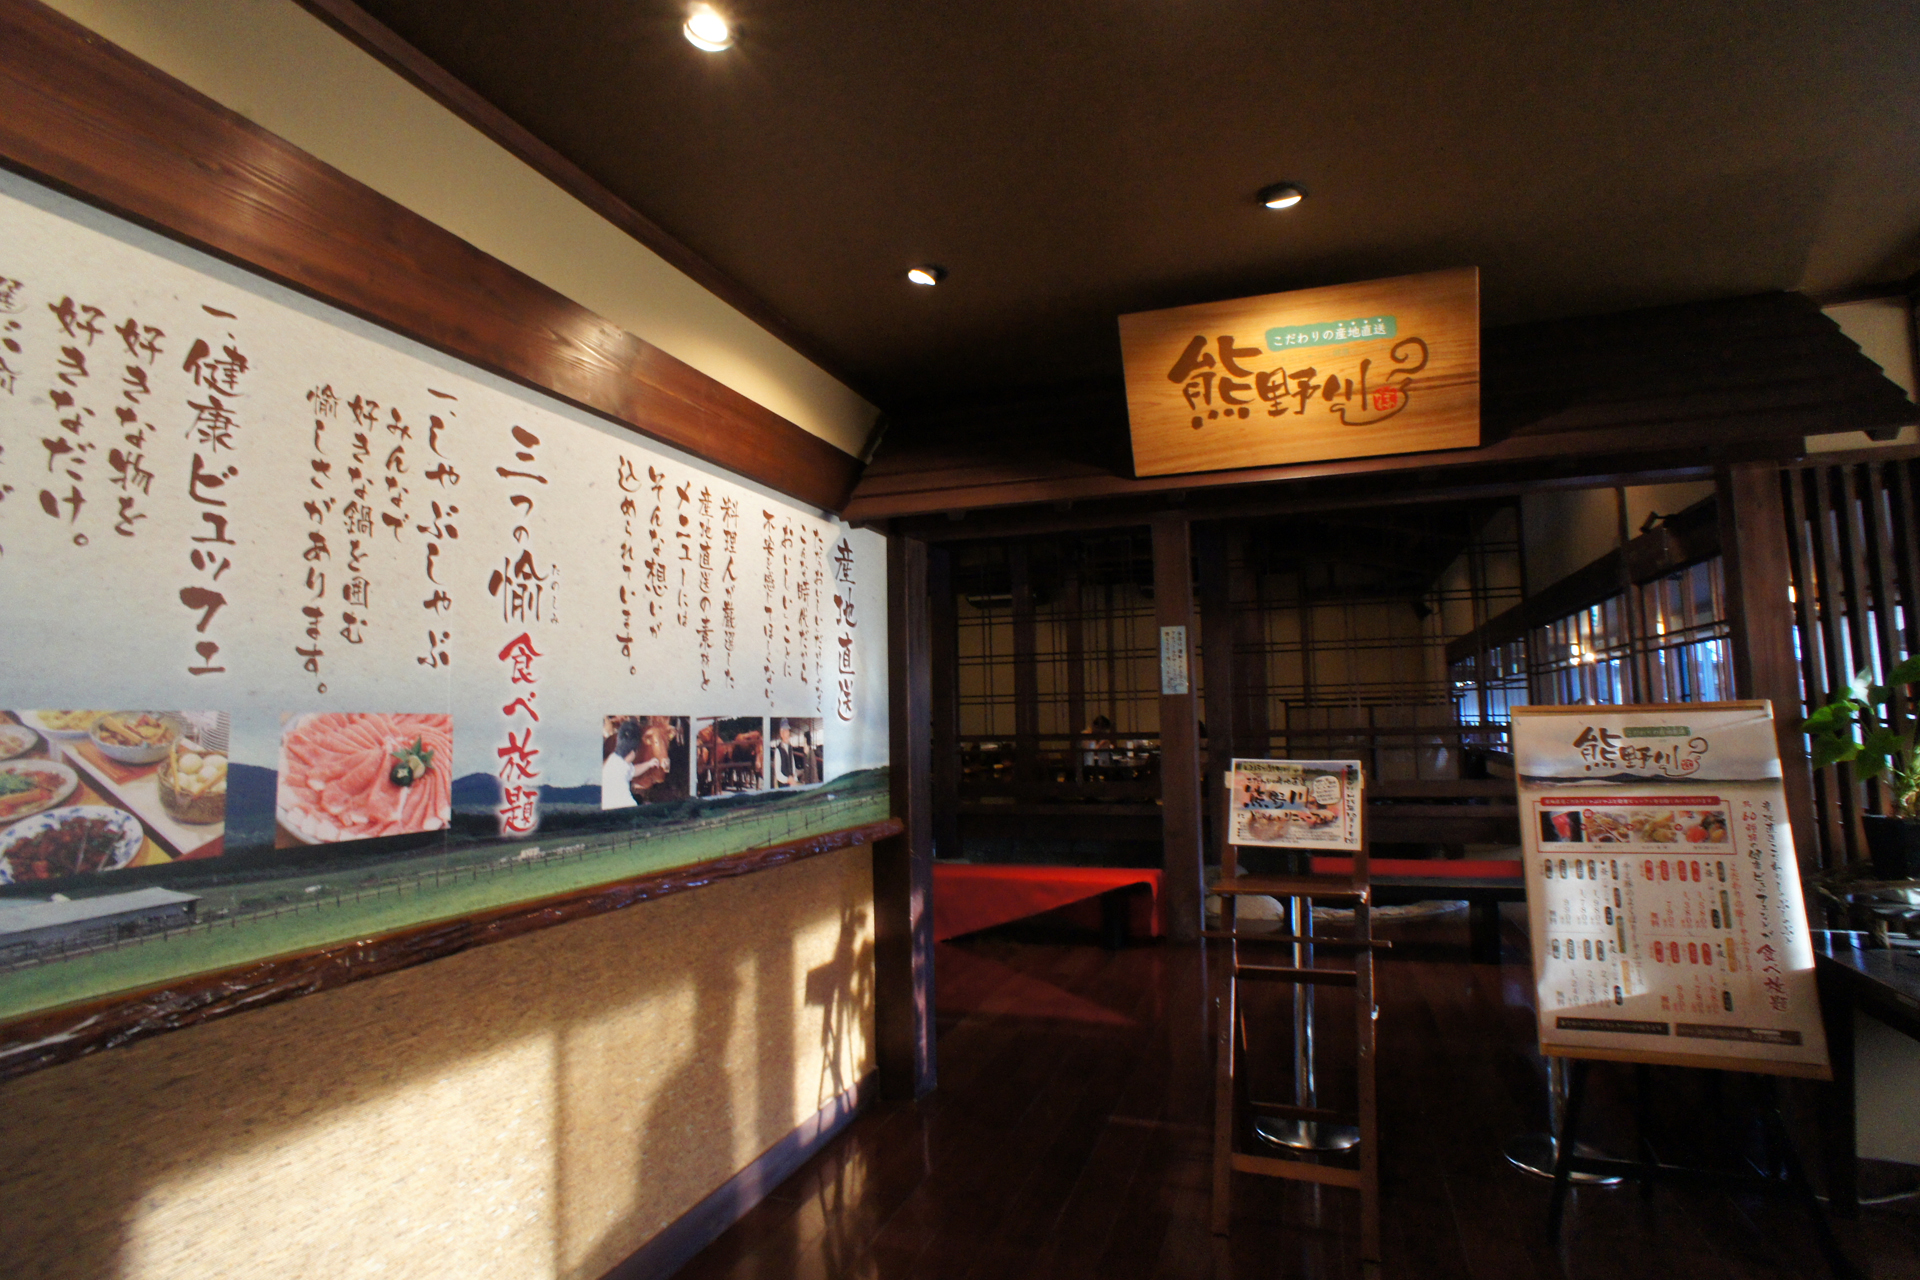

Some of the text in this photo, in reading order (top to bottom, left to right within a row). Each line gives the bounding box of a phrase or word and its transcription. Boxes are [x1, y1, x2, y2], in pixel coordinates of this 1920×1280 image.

[39, 296, 106, 546] 好きなだけ。
[1167, 335, 1369, 430] 熊野川
[1274, 319, 1387, 346] こだわりの産地直送
[108, 318, 166, 537] 好きな物を
[381, 407, 412, 542] みんなで
[295, 384, 339, 694] 愉しさがあります。
[339, 394, 380, 644] 好きな鍋を囲む
[550, 563, 560, 624] たのしみ
[616, 455, 638, 675] 込められています。
[644, 466, 668, 637] そんな想いが
[676, 481, 692, 627] メニューには
[696, 487, 713, 691] 産地直送の素材と
[720, 498, 738, 688] 料理人が厳選した
[781, 516, 793, 677] 「おいしい」ことに
[797, 525, 809, 684] こんな時代だから
[763, 510, 774, 707] 不安を感じてほしくない。
[834, 538, 857, 721] 産地直送
[1573, 726, 1679, 771] 熊野川
